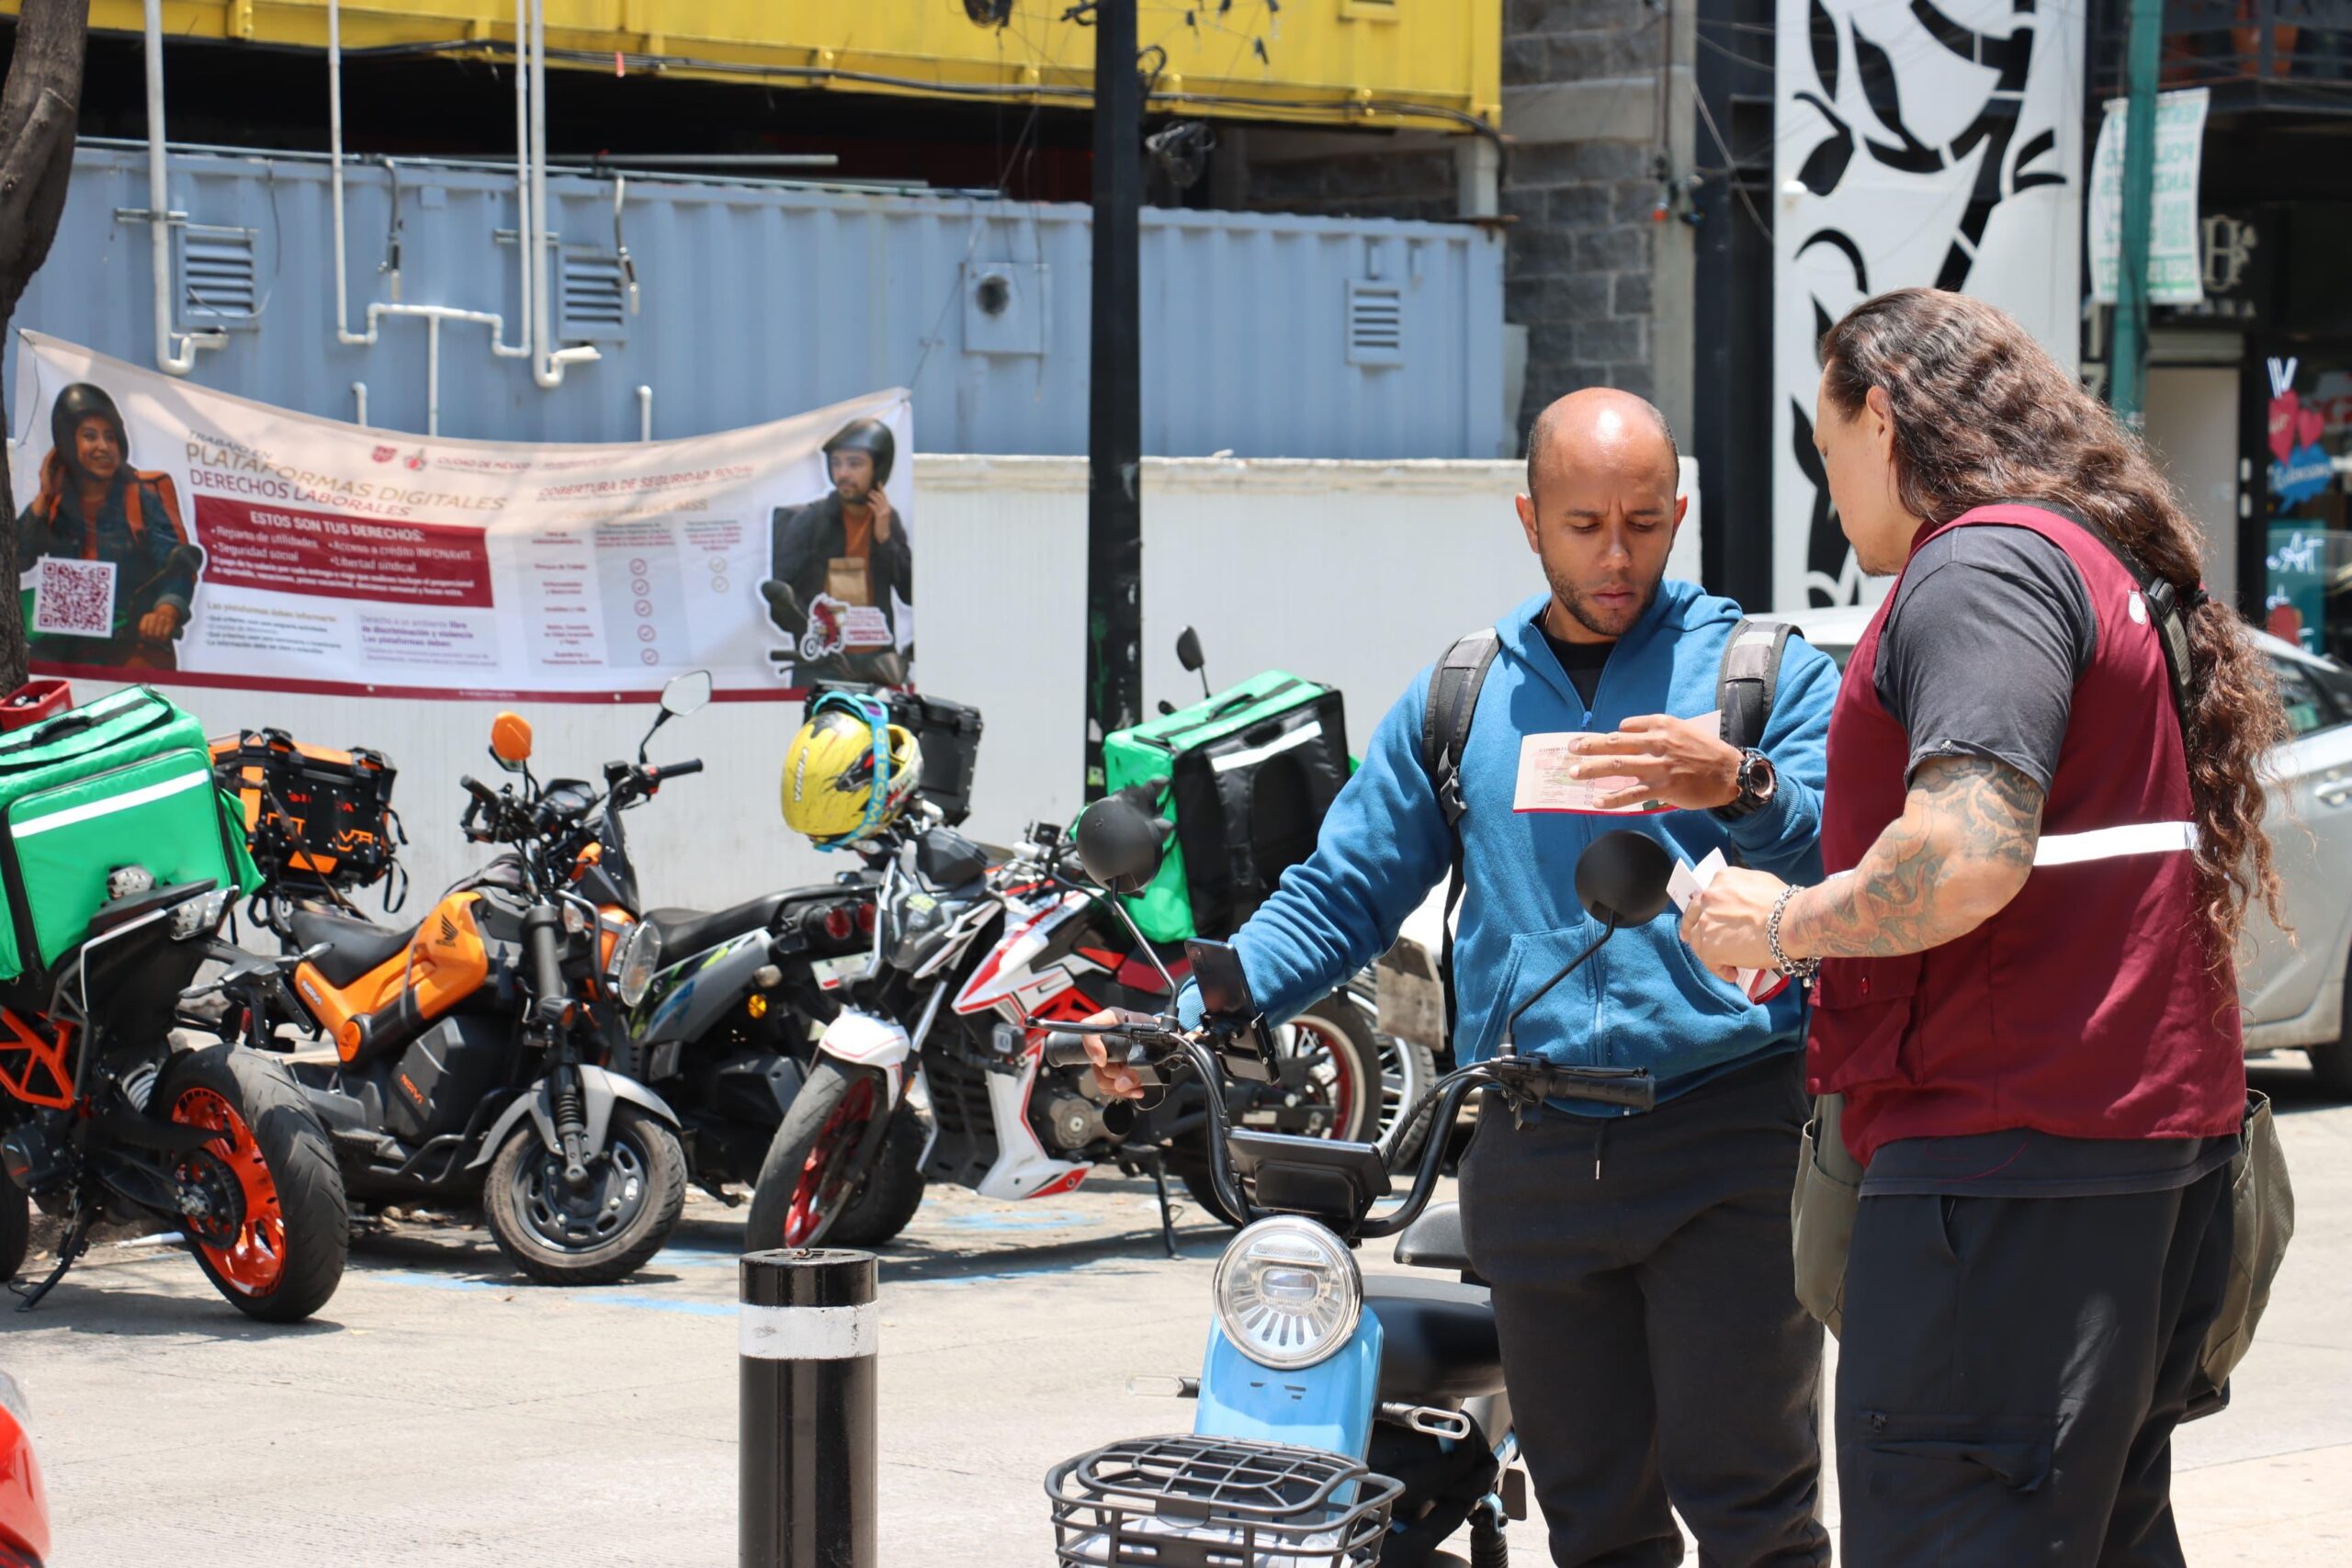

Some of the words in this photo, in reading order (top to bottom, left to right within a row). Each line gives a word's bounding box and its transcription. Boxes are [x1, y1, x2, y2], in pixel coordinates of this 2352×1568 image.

[186, 442, 373, 497] PLATAFORMAS
[379, 486, 509, 510] DIGITALES
[538, 480, 616, 498] COBERTURA
[620, 477, 638, 490] DE
[640, 469, 710, 488] SEGURIDAD
[189, 468, 289, 499] DERECHOS
[293, 486, 412, 517] LABORALES
[216, 525, 255, 541] Reparto
[256, 532, 269, 542] de
[271, 533, 319, 547] utilidades
[250, 511, 292, 528] ESTOS
[293, 517, 322, 533] SON
[323, 520, 350, 536] TUS
[351, 524, 426, 543] DERECHOS:
[219, 542, 268, 558] Seguridad
[269, 549, 300, 561] social
[334, 539, 369, 553] Acceso
[416, 547, 471, 559] INFONAVIT
[336, 557, 377, 570] Libertad
[378, 560, 417, 572] sindical
